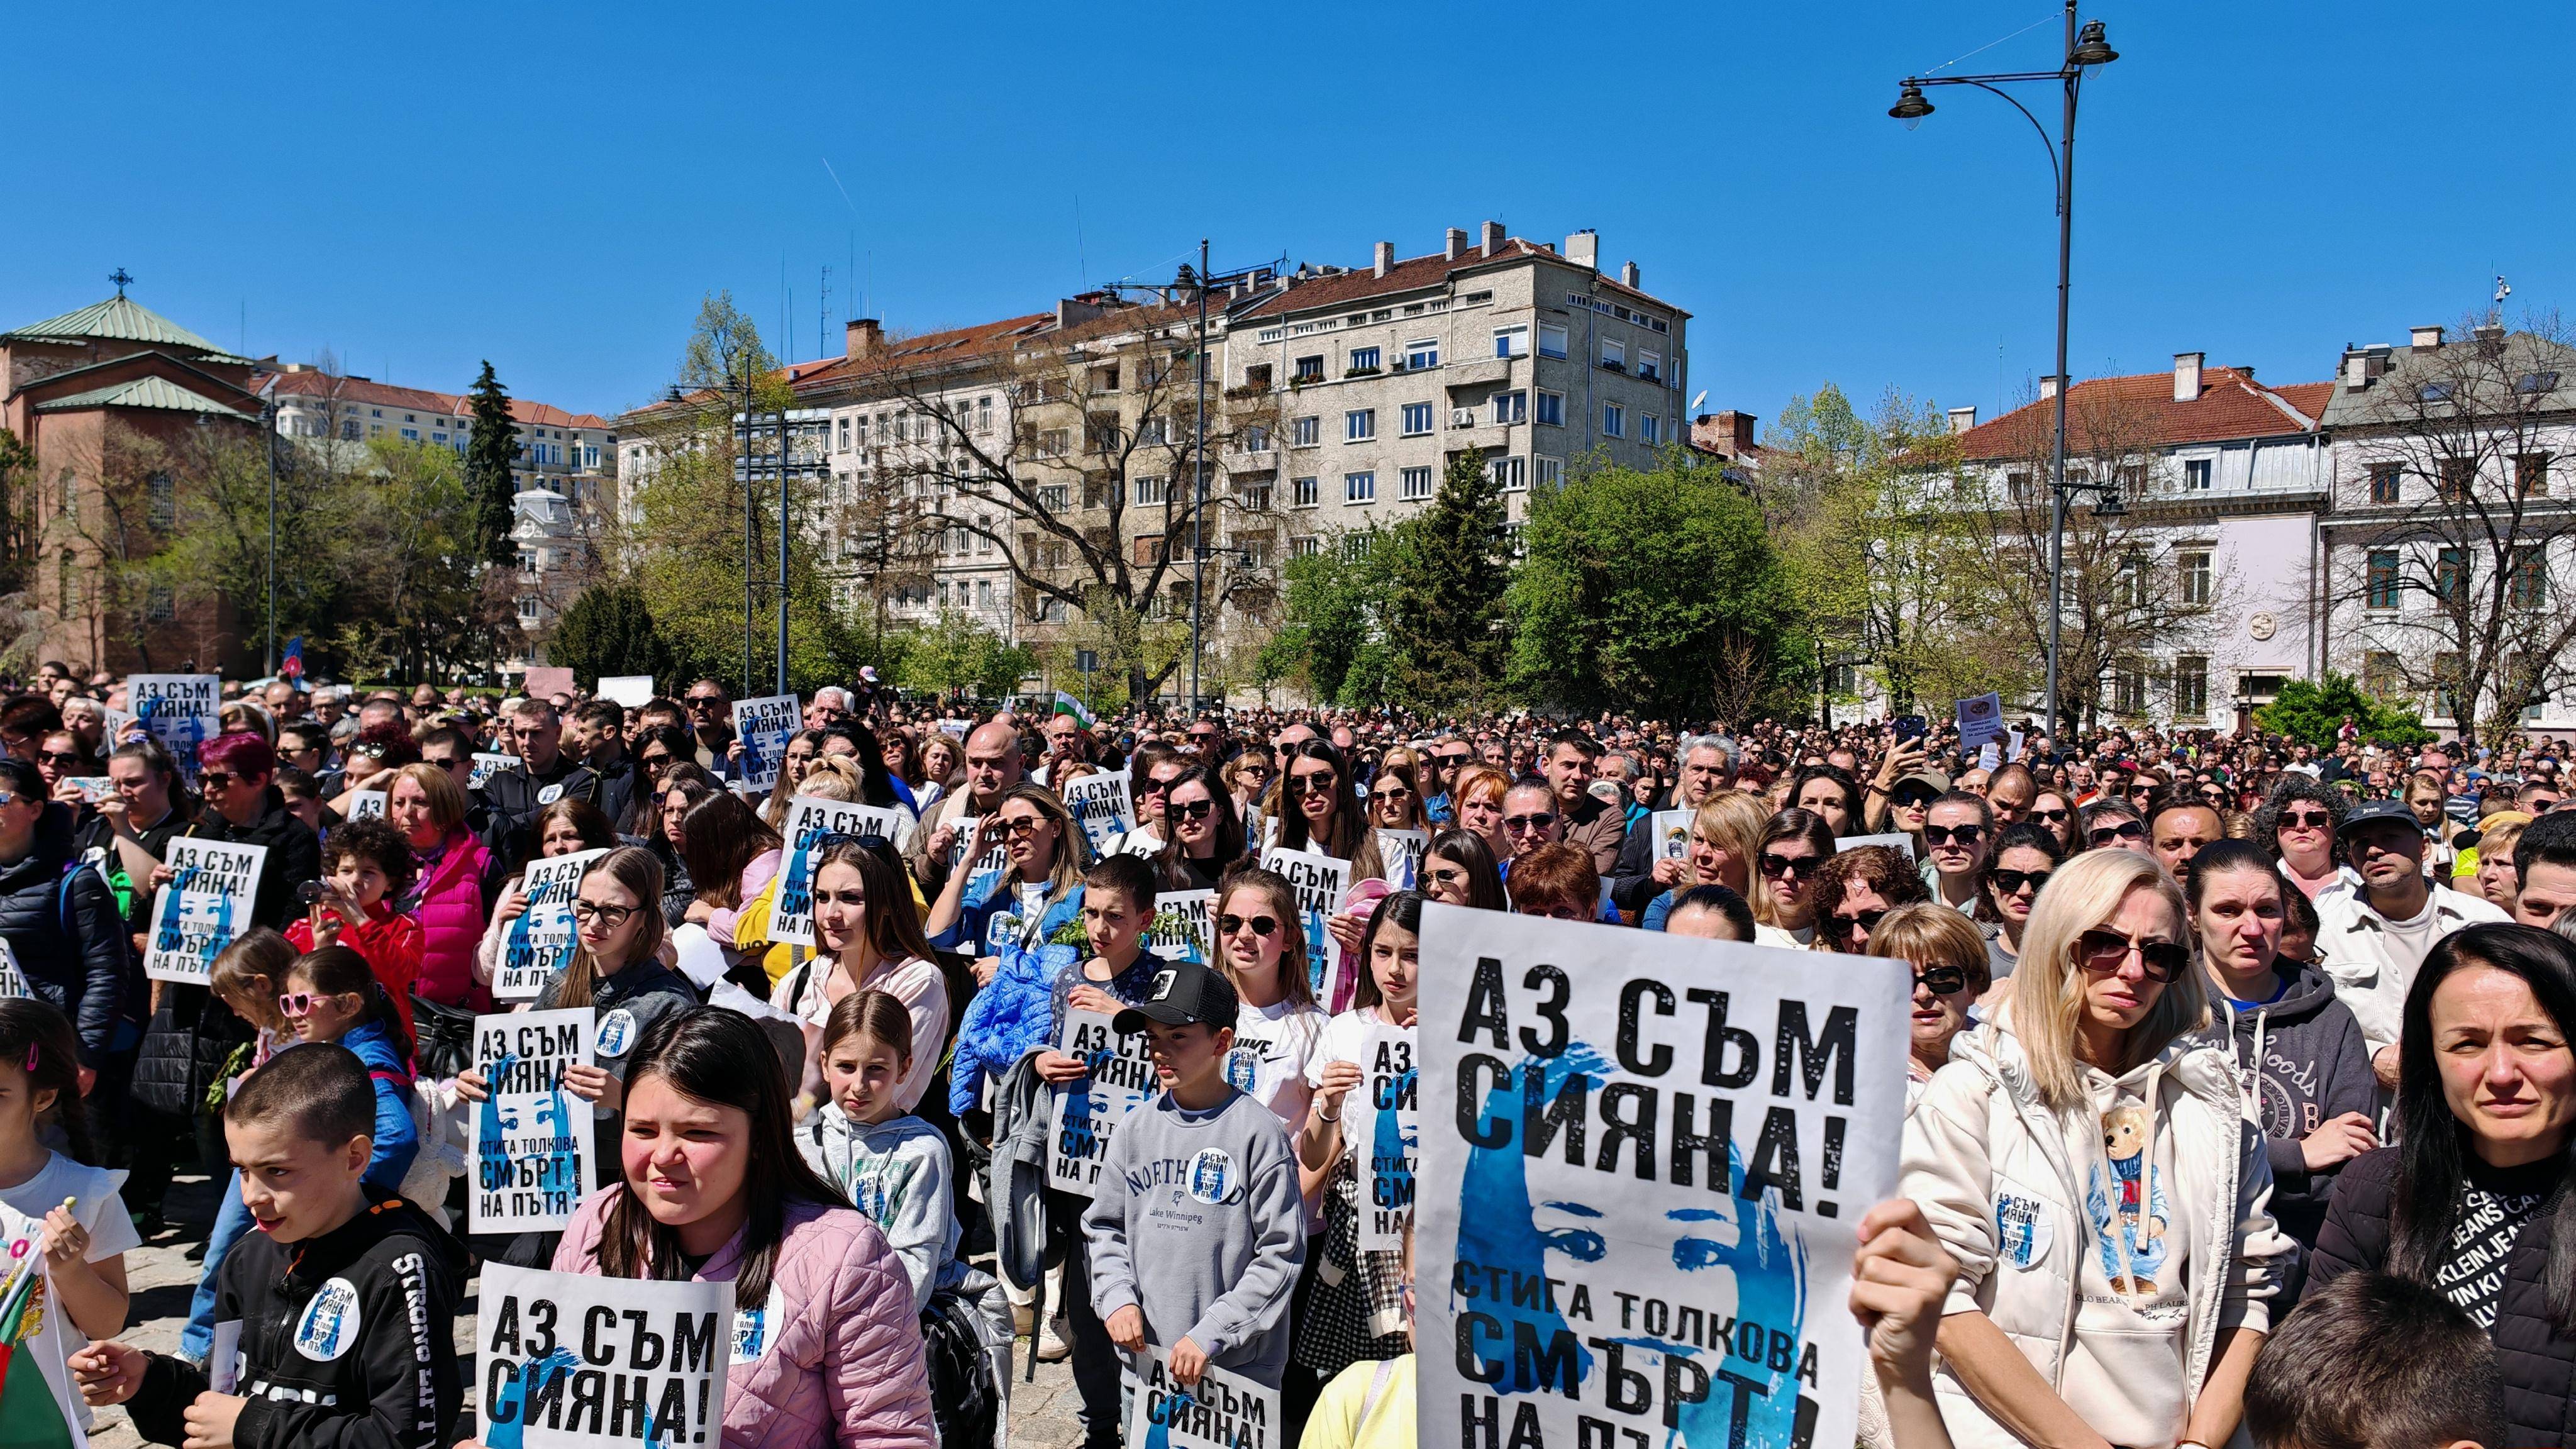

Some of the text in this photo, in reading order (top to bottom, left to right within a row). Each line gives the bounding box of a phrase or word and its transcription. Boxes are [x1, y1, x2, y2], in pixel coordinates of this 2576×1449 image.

[136, 682, 210, 699] АЗ СЪМ
[136, 700, 210, 718] СИЯНА!
[739, 701, 793, 720] АЗ СЪМ
[740, 715, 795, 736] СИЯНА!
[1067, 779, 1123, 803] АЗ СЪМ
[1068, 797, 1126, 819] СИЯНА!
[797, 806, 883, 836] АЗ СЪМ
[173, 847, 254, 875] АЗ СЪМ
[169, 869, 248, 897] СИЯНА!
[529, 867, 552, 888] АЗ
[1289, 860, 1339, 892] СЪМ
[526, 881, 573, 907] СИЯН
[160, 918, 236, 935] СТИГА ТОЛКОВА
[777, 915, 796, 933] НА
[508, 933, 538, 945] СТИГА
[152, 953, 210, 974] НА ПЪТ
[502, 970, 522, 987] НА
[480, 1024, 579, 1061] АЗ СЪМ
[1073, 1023, 1107, 1052] АЗ
[1457, 956, 1858, 1107] АЗ СЪМ
[1241, 1052, 1257, 1060] СЪМ
[1373, 1041, 1411, 1074] АЗ
[1062, 1114, 1101, 1133] СТИГА
[479, 1136, 579, 1156] СТИГА ТОЛКОВА
[1455, 1053, 1847, 1219] СИЯНА!
[1055, 1157, 1080, 1181] НА
[1197, 1160, 1227, 1173] СИЯНА!
[1199, 1152, 1228, 1164] АЗ СЪМ
[480, 1194, 504, 1218] НА
[1997, 1192, 2040, 1214] АЗ СЪМ
[1150, 1207, 1202, 1224] Lake Winnipeg
[1374, 1211, 1404, 1234] НА
[1997, 1204, 2038, 1226] СИЯНА!
[2452, 1203, 2505, 1250] JEANS
[2436, 1245, 2493, 1285] KLEIN
[315, 1296, 349, 1318] СИЯНА!
[332, 1287, 355, 1305] СЪМ
[2075, 1293, 2190, 1309] OLO BEAR LAURE
[391, 1253, 431, 1362] STRONG
[490, 1295, 718, 1374] АЗ СЪМ
[1454, 1260, 1819, 1390] СТИГА ТОЛКОВА
[296, 1337, 306, 1348] НА
[486, 1358, 711, 1443] СИЯНА!
[1197, 1375, 1265, 1427] СЪМ
[1460, 1394, 1544, 1449] НА
